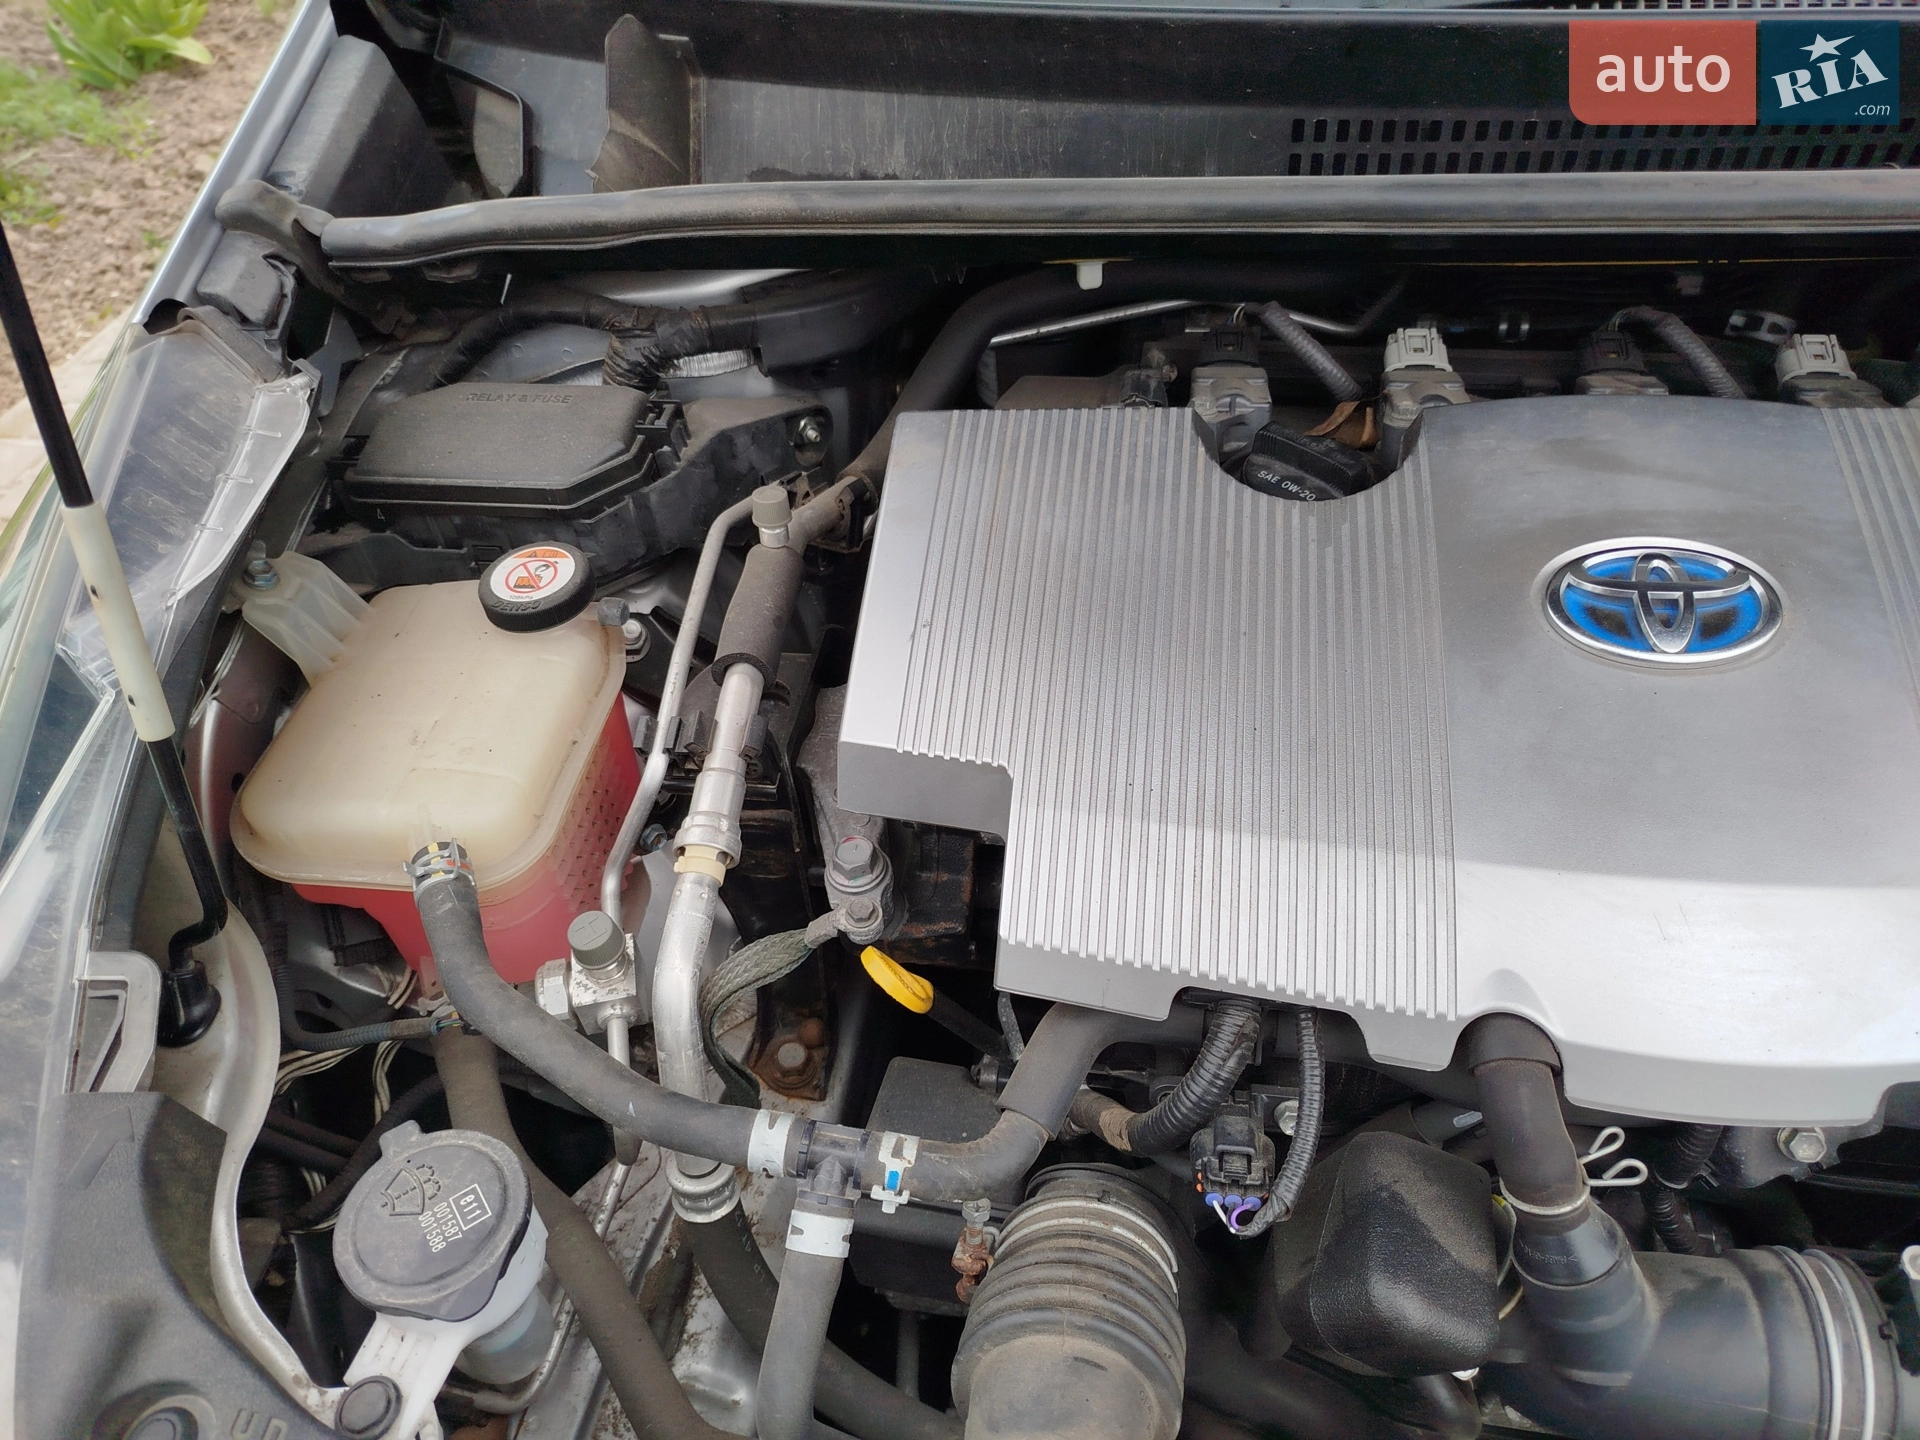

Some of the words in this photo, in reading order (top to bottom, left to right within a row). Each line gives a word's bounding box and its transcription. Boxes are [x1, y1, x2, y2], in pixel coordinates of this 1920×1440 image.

[465, 392, 516, 402] RELAY
[532, 394, 573, 404] FUSE
[1257, 470, 1281, 484] SAE
[1281, 480, 1316, 501] 0W-20
[491, 600, 542, 612] DENSO
[460, 1194, 482, 1220] e11
[418, 1211, 447, 1253] 001588
[433, 1202, 463, 1242] 001587
